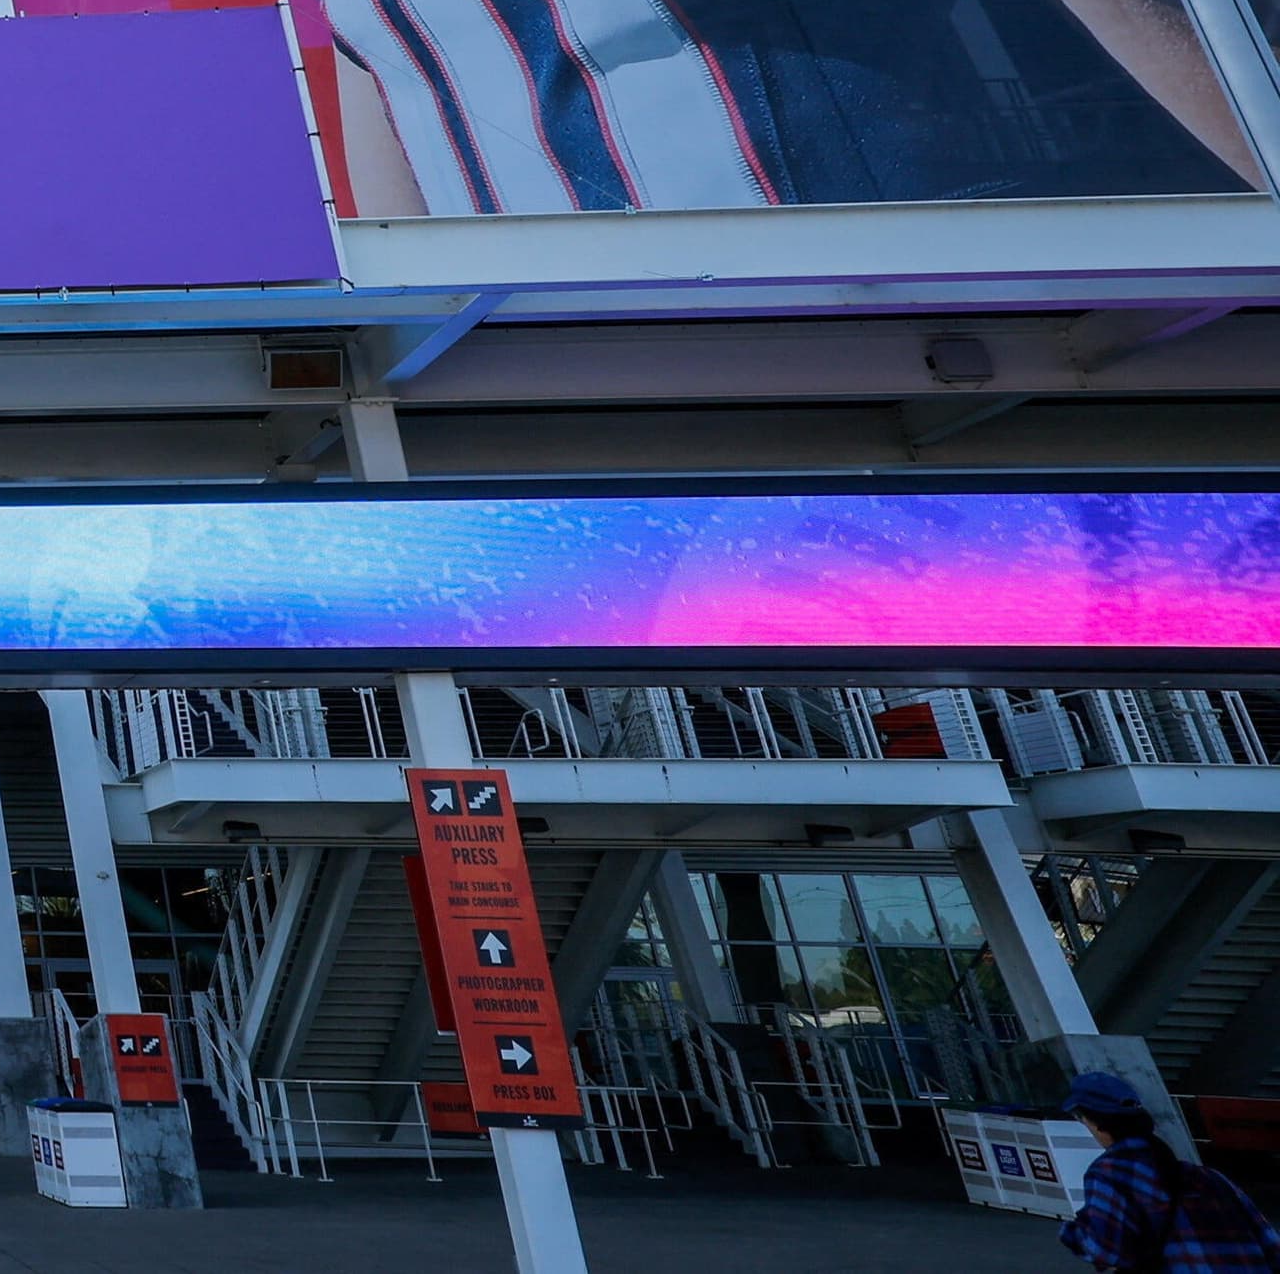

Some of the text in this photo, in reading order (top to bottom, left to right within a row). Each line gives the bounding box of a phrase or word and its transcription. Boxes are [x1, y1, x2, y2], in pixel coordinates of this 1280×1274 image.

[434, 825, 506, 843] AUXILIARY
[451, 847, 498, 866] PRESS
[449, 881, 469, 892] TAKE
[471, 881, 500, 892] STAIRS
[472, 897, 520, 908] CONCOURSE
[458, 976, 546, 992] PHOTOGRAPHER
[473, 998, 540, 1014] WORKROOM
[493, 1085, 558, 1102] PRESS BOX
